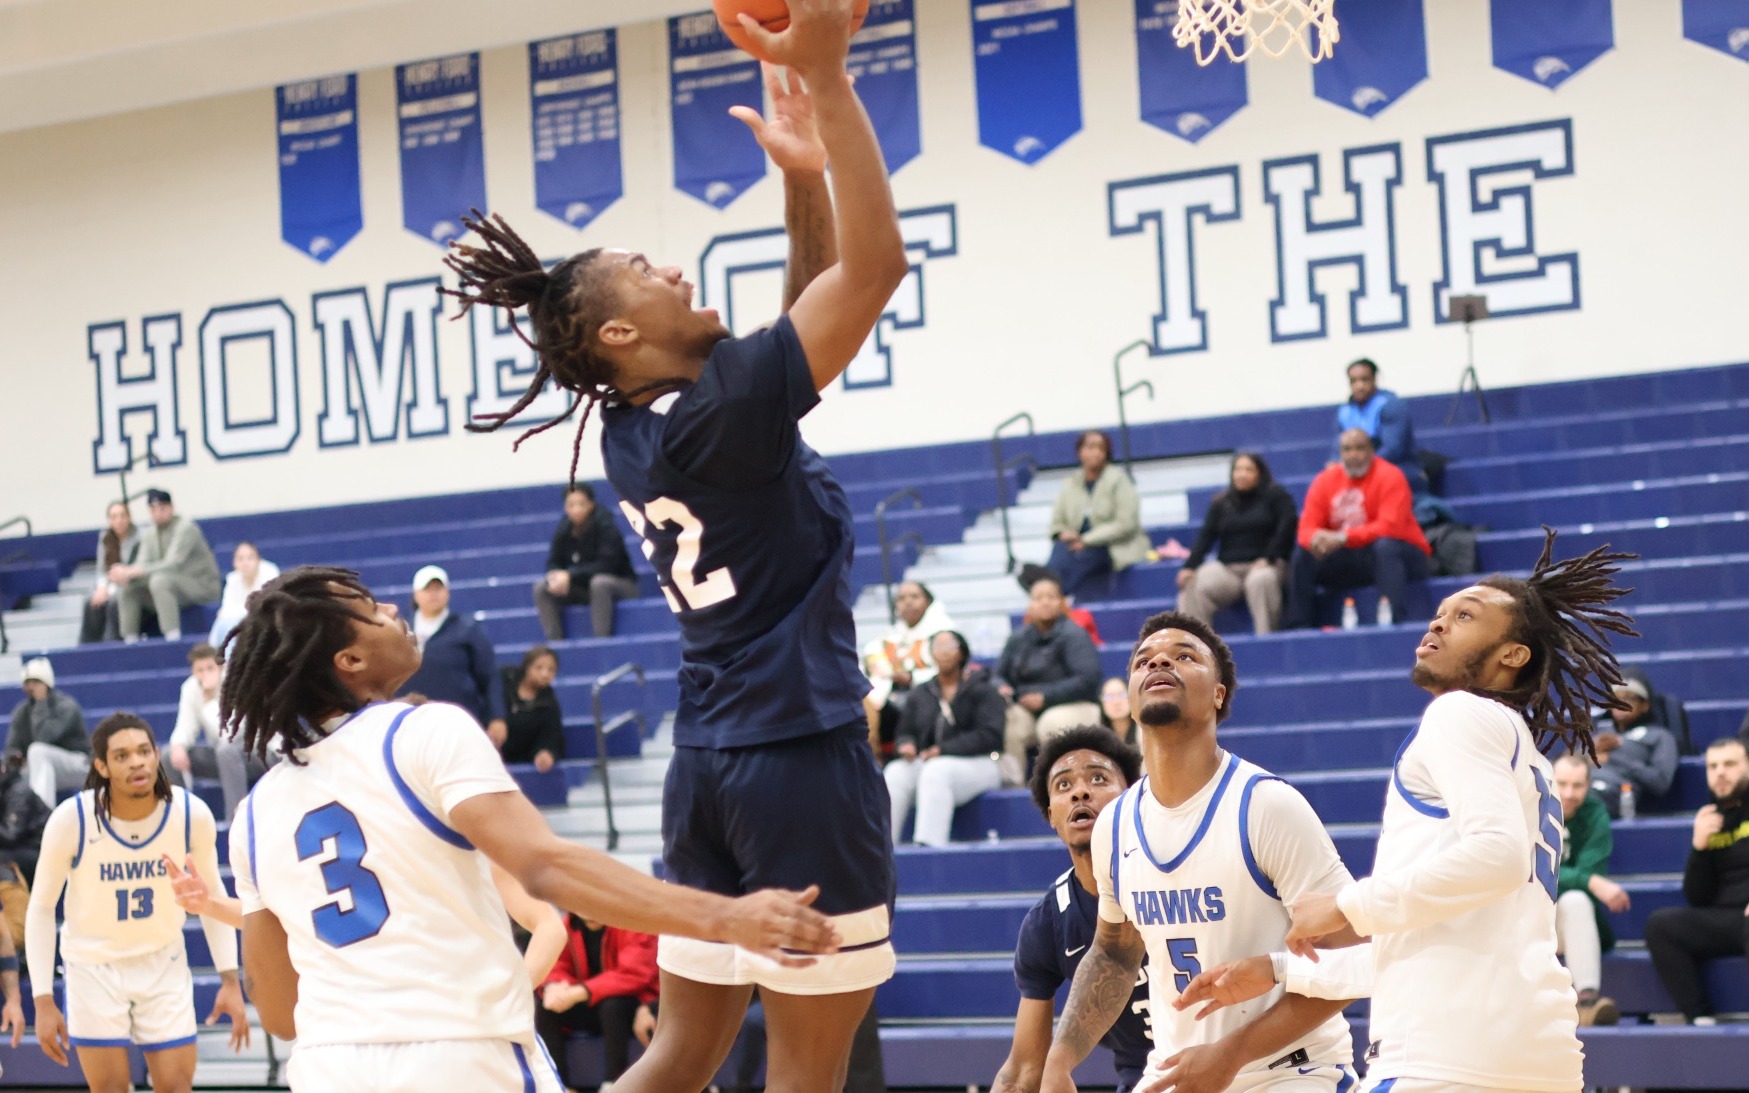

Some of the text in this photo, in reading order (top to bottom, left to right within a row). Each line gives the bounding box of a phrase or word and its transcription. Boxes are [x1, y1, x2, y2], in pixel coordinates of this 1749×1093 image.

[88, 257, 573, 476] HOME
[1107, 117, 1581, 357] THE
[99, 859, 167, 882] HAWKS
[294, 800, 391, 949] 3
[115, 887, 155, 922] 13
[1131, 886, 1226, 926] HAWKS
[1166, 937, 1201, 994] 5
